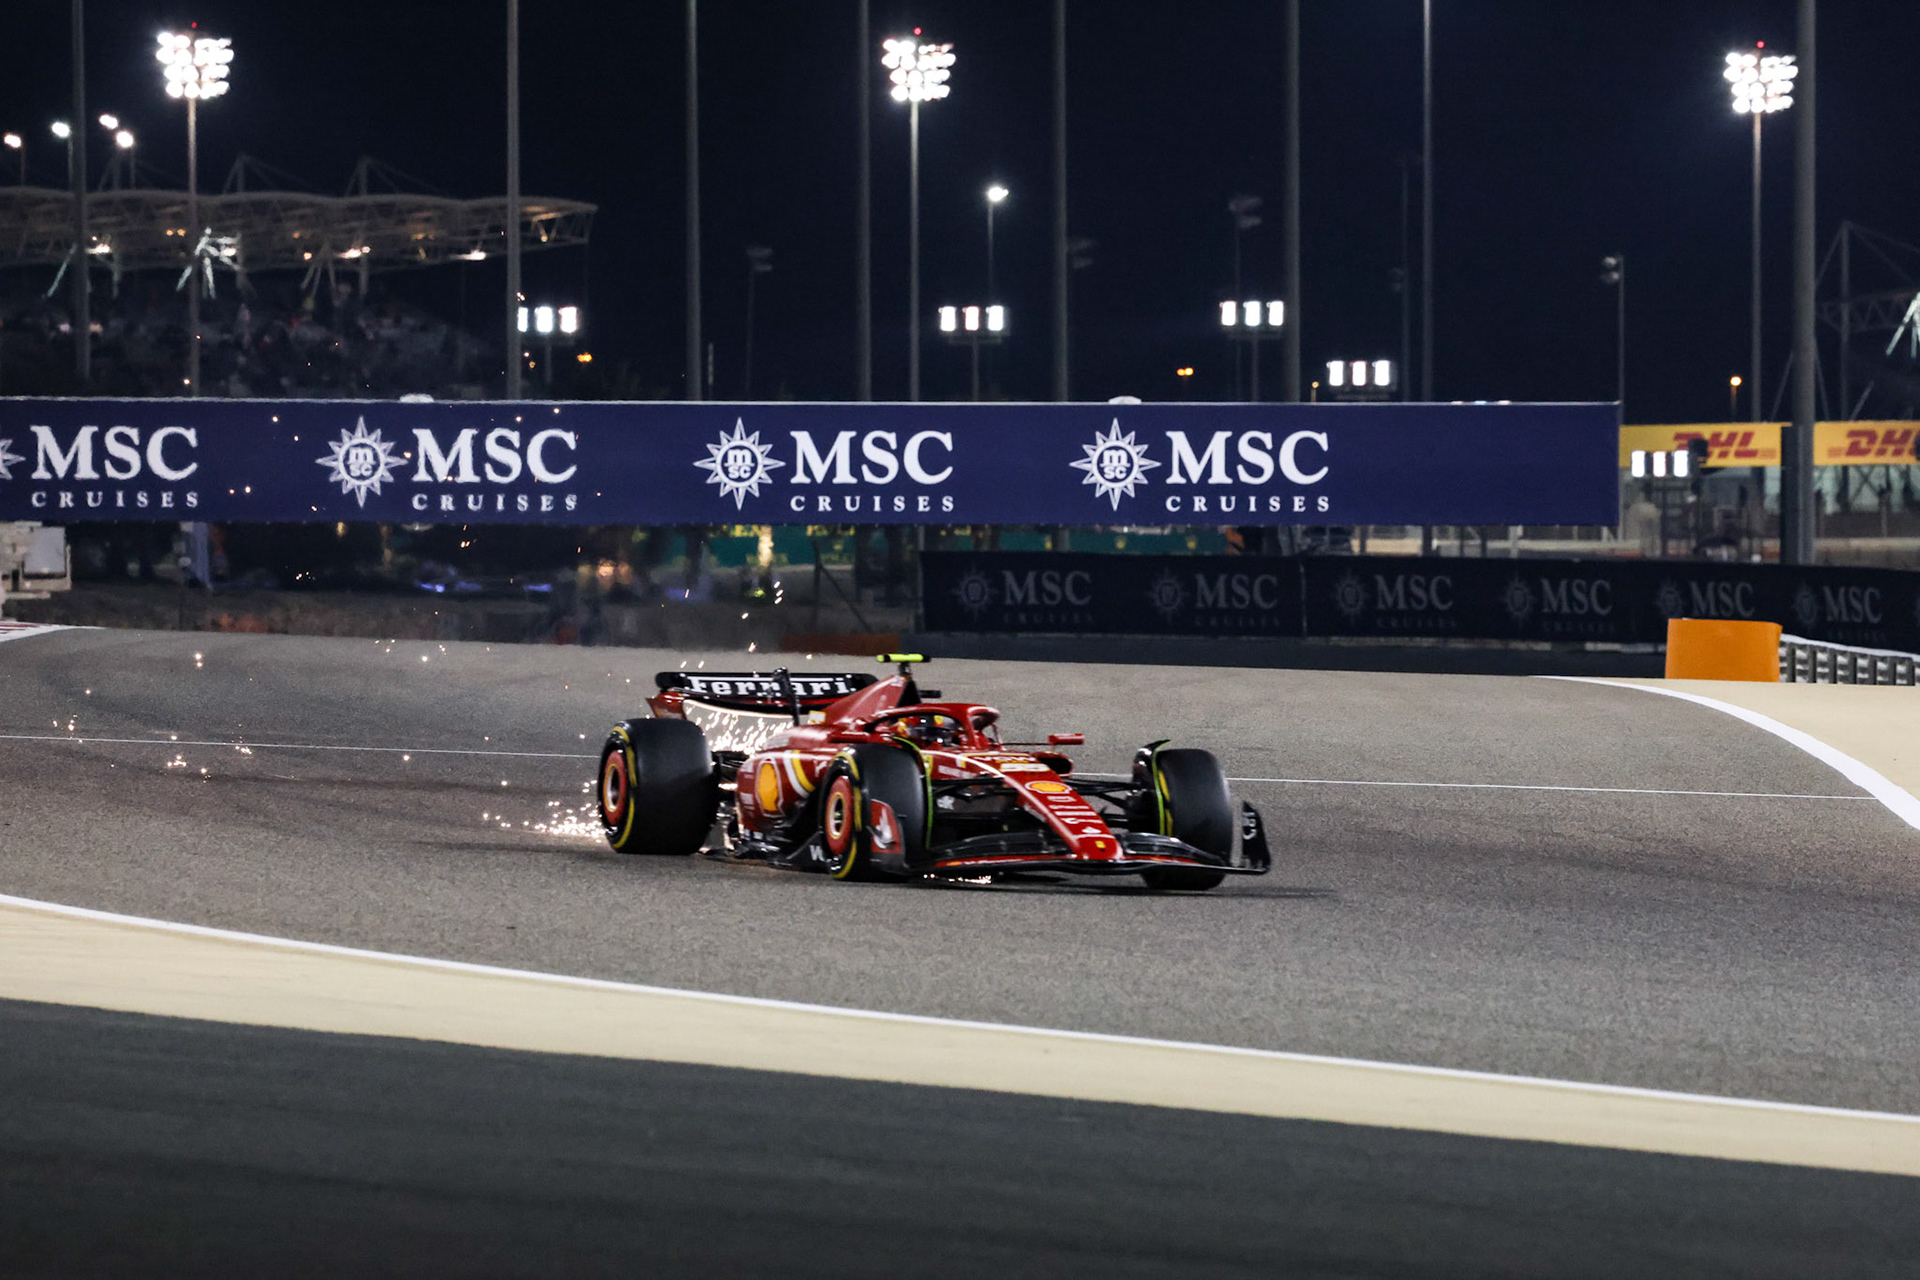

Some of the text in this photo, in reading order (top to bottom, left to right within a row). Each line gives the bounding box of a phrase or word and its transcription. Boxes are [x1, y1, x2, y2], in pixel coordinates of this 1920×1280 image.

[30, 425, 198, 481] MSC
[411, 427, 578, 484] MSC
[789, 430, 954, 485] MSC
[1165, 430, 1329, 485] MSC
[31, 491, 198, 508] CRUISES
[412, 493, 578, 512] CRUISES
[790, 495, 954, 512] CRUISES
[1165, 495, 1330, 513] CRUISES
[1002, 570, 1092, 606] MSC
[1195, 573, 1279, 610] MSC
[1374, 574, 1454, 610] MSC
[1540, 577, 1613, 616] MSC
[1690, 580, 1756, 617] MSC
[1822, 585, 1884, 624] MSC
[687, 676, 849, 696] Ferrari
